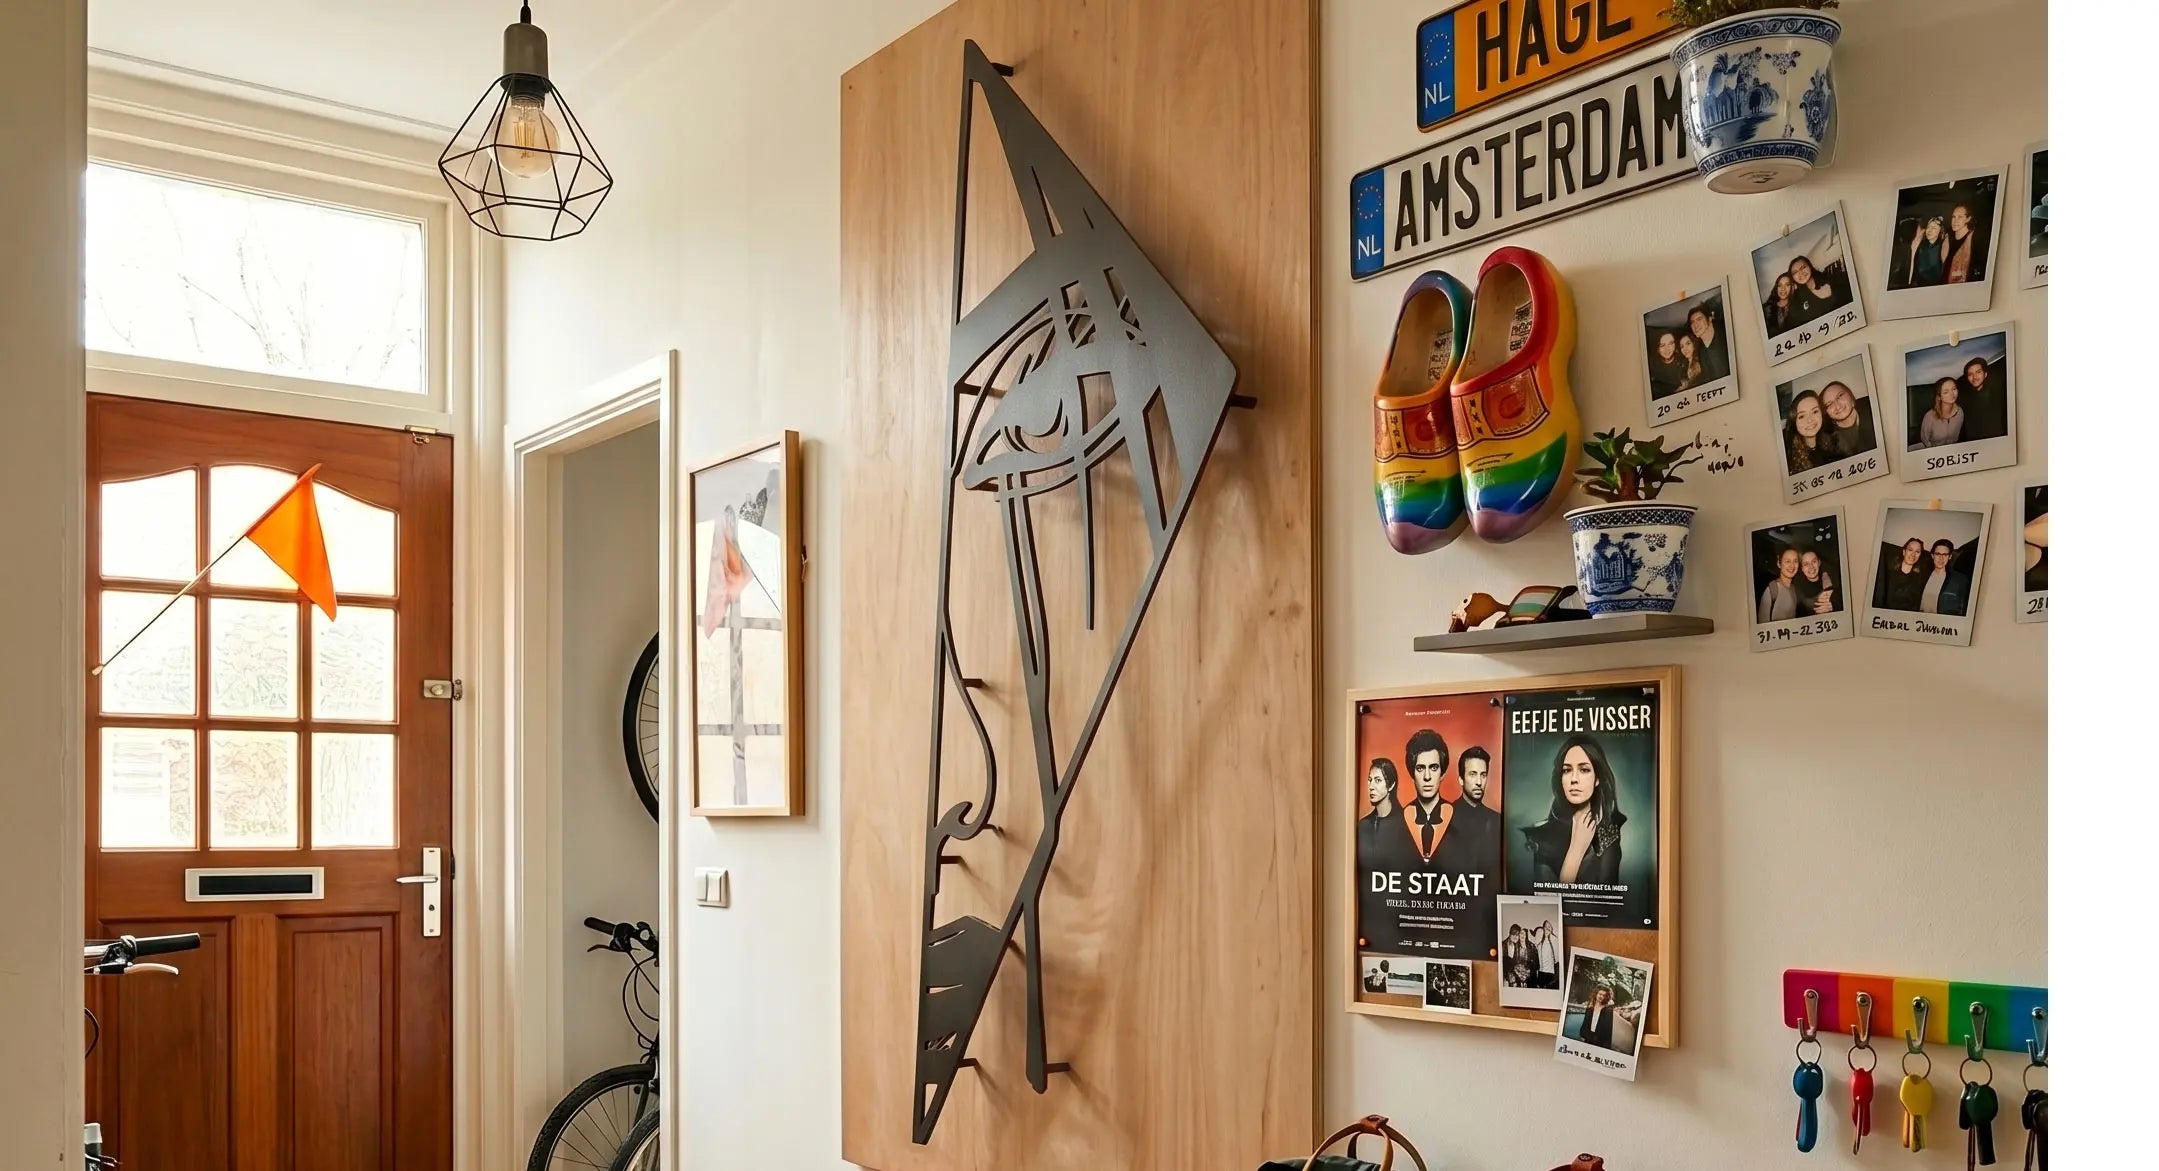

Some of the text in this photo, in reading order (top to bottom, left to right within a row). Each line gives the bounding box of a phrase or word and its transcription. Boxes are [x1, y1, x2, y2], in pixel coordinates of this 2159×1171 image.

[1424, 81, 1451, 109] NL
[1394, 71, 1688, 252] AMSTERDAM
[1357, 235, 1381, 261] NL
[1512, 704, 1651, 734] EEFJE DE VISSER
[1371, 871, 1485, 896] DE STAAT
